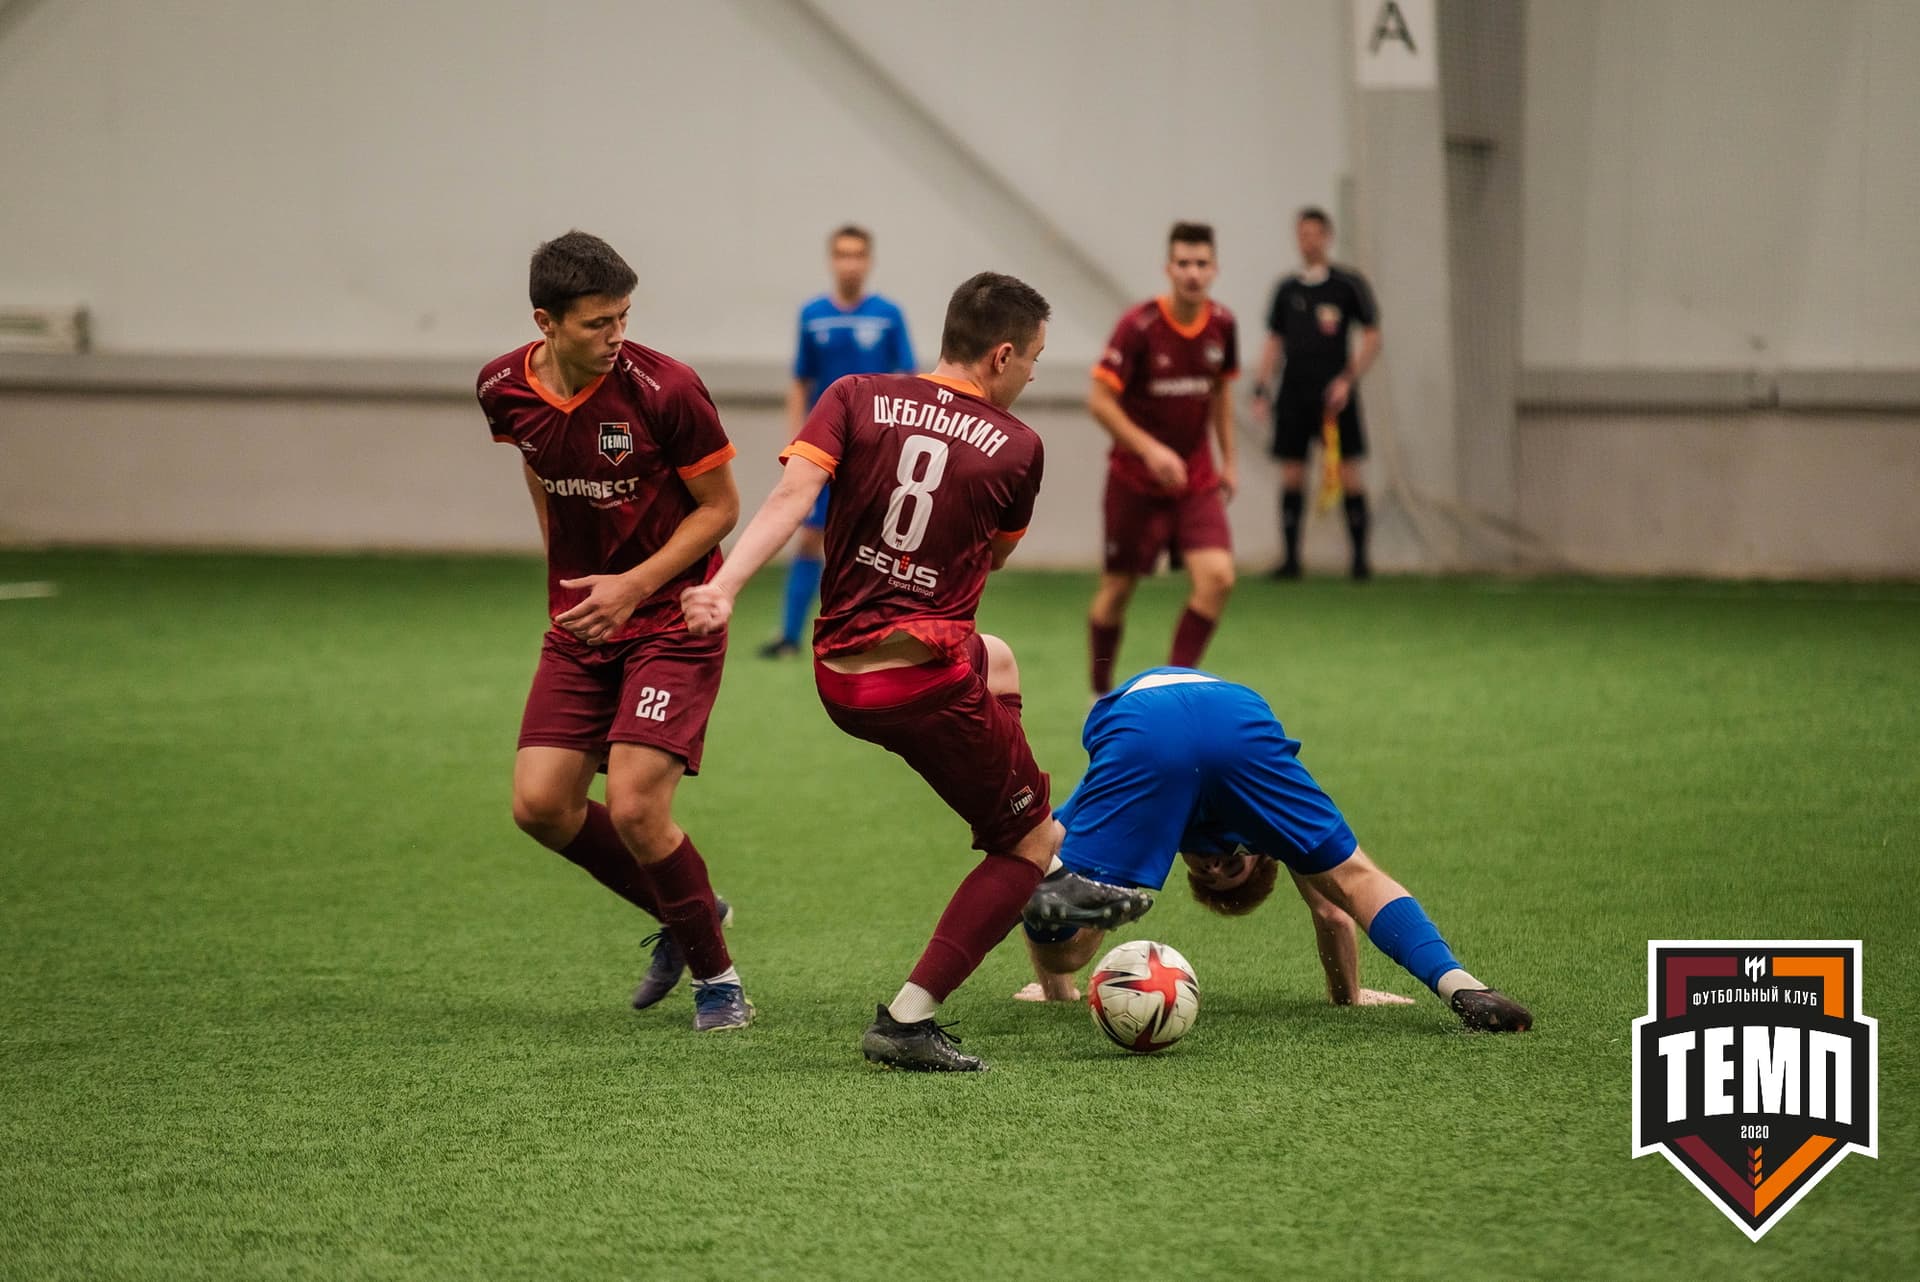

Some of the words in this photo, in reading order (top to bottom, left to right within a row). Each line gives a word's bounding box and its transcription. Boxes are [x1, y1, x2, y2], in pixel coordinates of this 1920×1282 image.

[602, 434, 629, 450] ТЕМП
[874, 395, 1009, 458] ЩЕБЛЫКИН
[881, 434, 949, 552] 8
[912, 584, 934, 598] Union
[635, 686, 671, 721] 22
